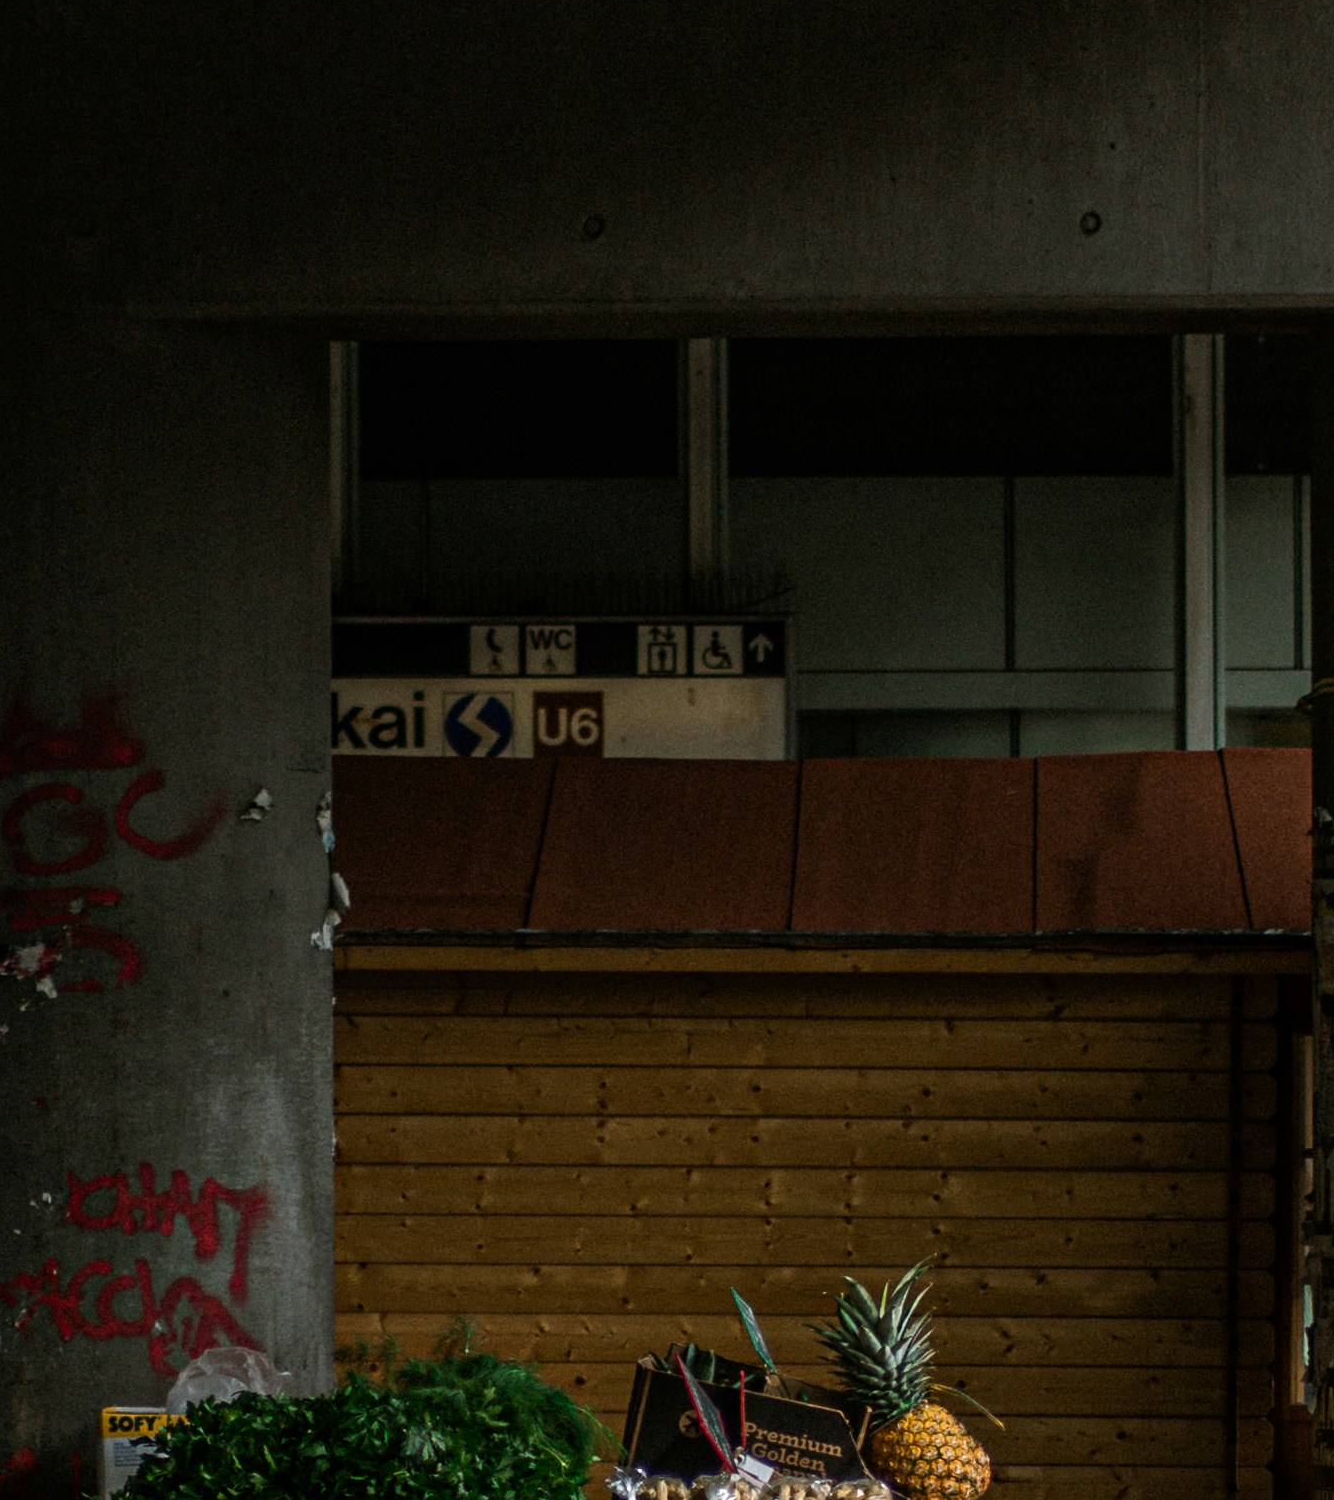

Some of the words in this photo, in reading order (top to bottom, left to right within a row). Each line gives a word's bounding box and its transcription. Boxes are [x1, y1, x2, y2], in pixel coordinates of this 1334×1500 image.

[529, 629, 573, 651] WC
[331, 691, 425, 749] kai
[536, 707, 600, 747] U6
[108, 1416, 157, 1432] SOFY
[744, 1420, 843, 1458] Premium
[751, 1441, 827, 1472] Golden
